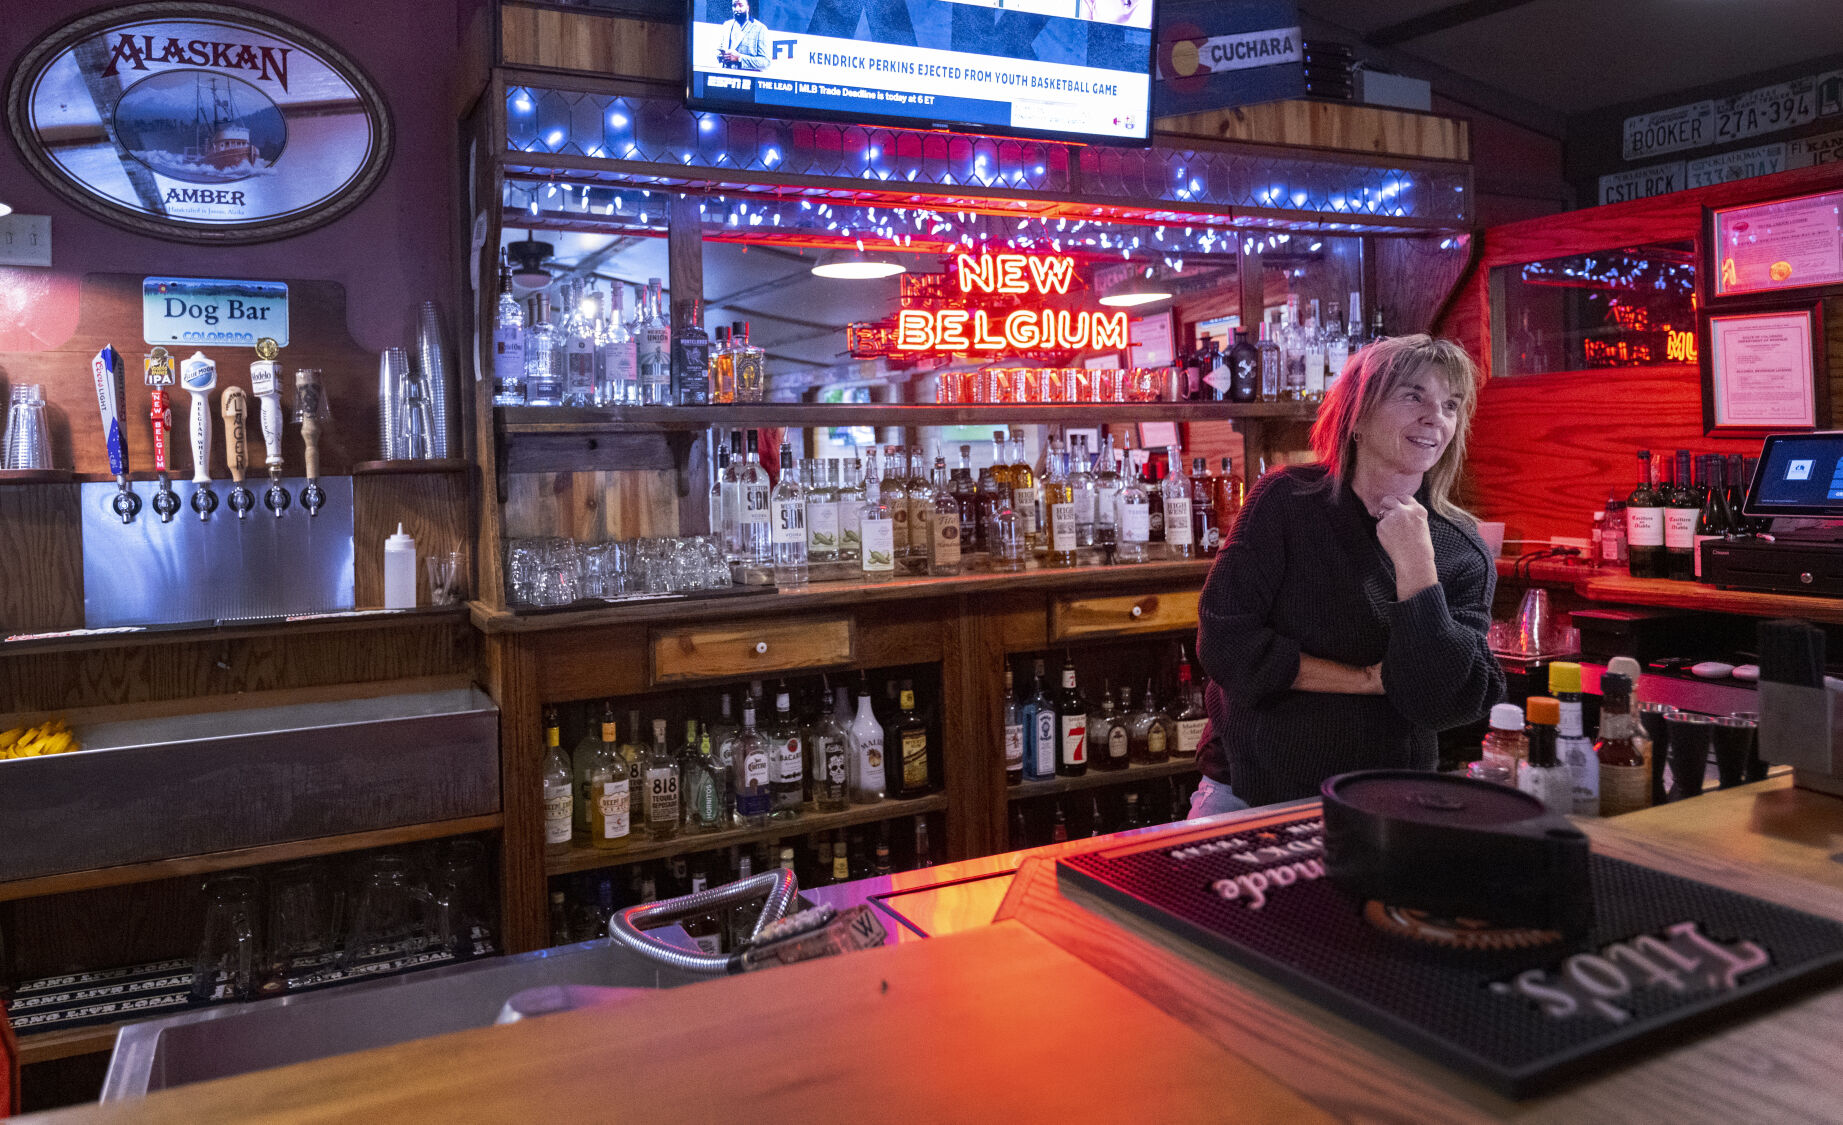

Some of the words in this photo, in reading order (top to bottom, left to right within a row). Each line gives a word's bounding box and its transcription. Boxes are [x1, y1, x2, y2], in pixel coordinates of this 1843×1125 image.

[772, 39, 797, 60] FT
[1210, 36, 1294, 63] CUCHARA
[100, 33, 293, 95] ALASKAN
[809, 51, 866, 70] KENDRICK
[869, 57, 915, 75] PERKINS
[918, 63, 961, 80] EJECTED
[964, 68, 992, 83] FROM
[995, 72, 1028, 88] YOUTH
[1031, 75, 1090, 94] BASKETBALL
[1092, 83, 1118, 96] GAME
[757, 81, 773, 91] THE
[773, 82, 793, 92] LEAD
[799, 84, 818, 94] MLB
[819, 86, 841, 96] Trade
[842, 87, 876, 100] Deadline
[876, 91, 885, 101] is
[885, 92, 906, 104] today
[907, 95, 917, 103] at
[917, 95, 923, 104] 6
[924, 96, 935, 105] ET
[1719, 94, 1810, 137] 27A-394
[1631, 118, 1702, 153] BOOKER
[164, 187, 247, 207] AMBER
[957, 253, 1075, 295] NEW
[164, 297, 220, 326] Dog
[226, 299, 271, 321] Bar
[183, 331, 254, 342] COLORADO
[647, 334, 669, 342] UNION
[897, 309, 1129, 351] BELGIUM
[94, 360, 104, 387] Coors
[149, 374, 171, 385] IPA
[98, 388, 107, 412] LIGHT
[153, 394, 161, 414] NEW
[154, 421, 165, 469] BELGIUM
[233, 399, 245, 471] LAGER
[747, 491, 769, 511] SON
[1167, 501, 1187, 511] HIGH
[780, 509, 804, 530] SON
[860, 738, 884, 749] MALI
[1068, 727, 1086, 761] 7
[779, 752, 801, 761] BACAR
[652, 777, 677, 794] 818
[705, 784, 713, 819] HORNITOS
[12, 993, 71, 1009] LONG
[75, 985, 124, 1001] LIVE
[128, 976, 192, 993] LOCAL
[65, 1004, 117, 1019] LIVE
[121, 995, 188, 1011] LOCAL
